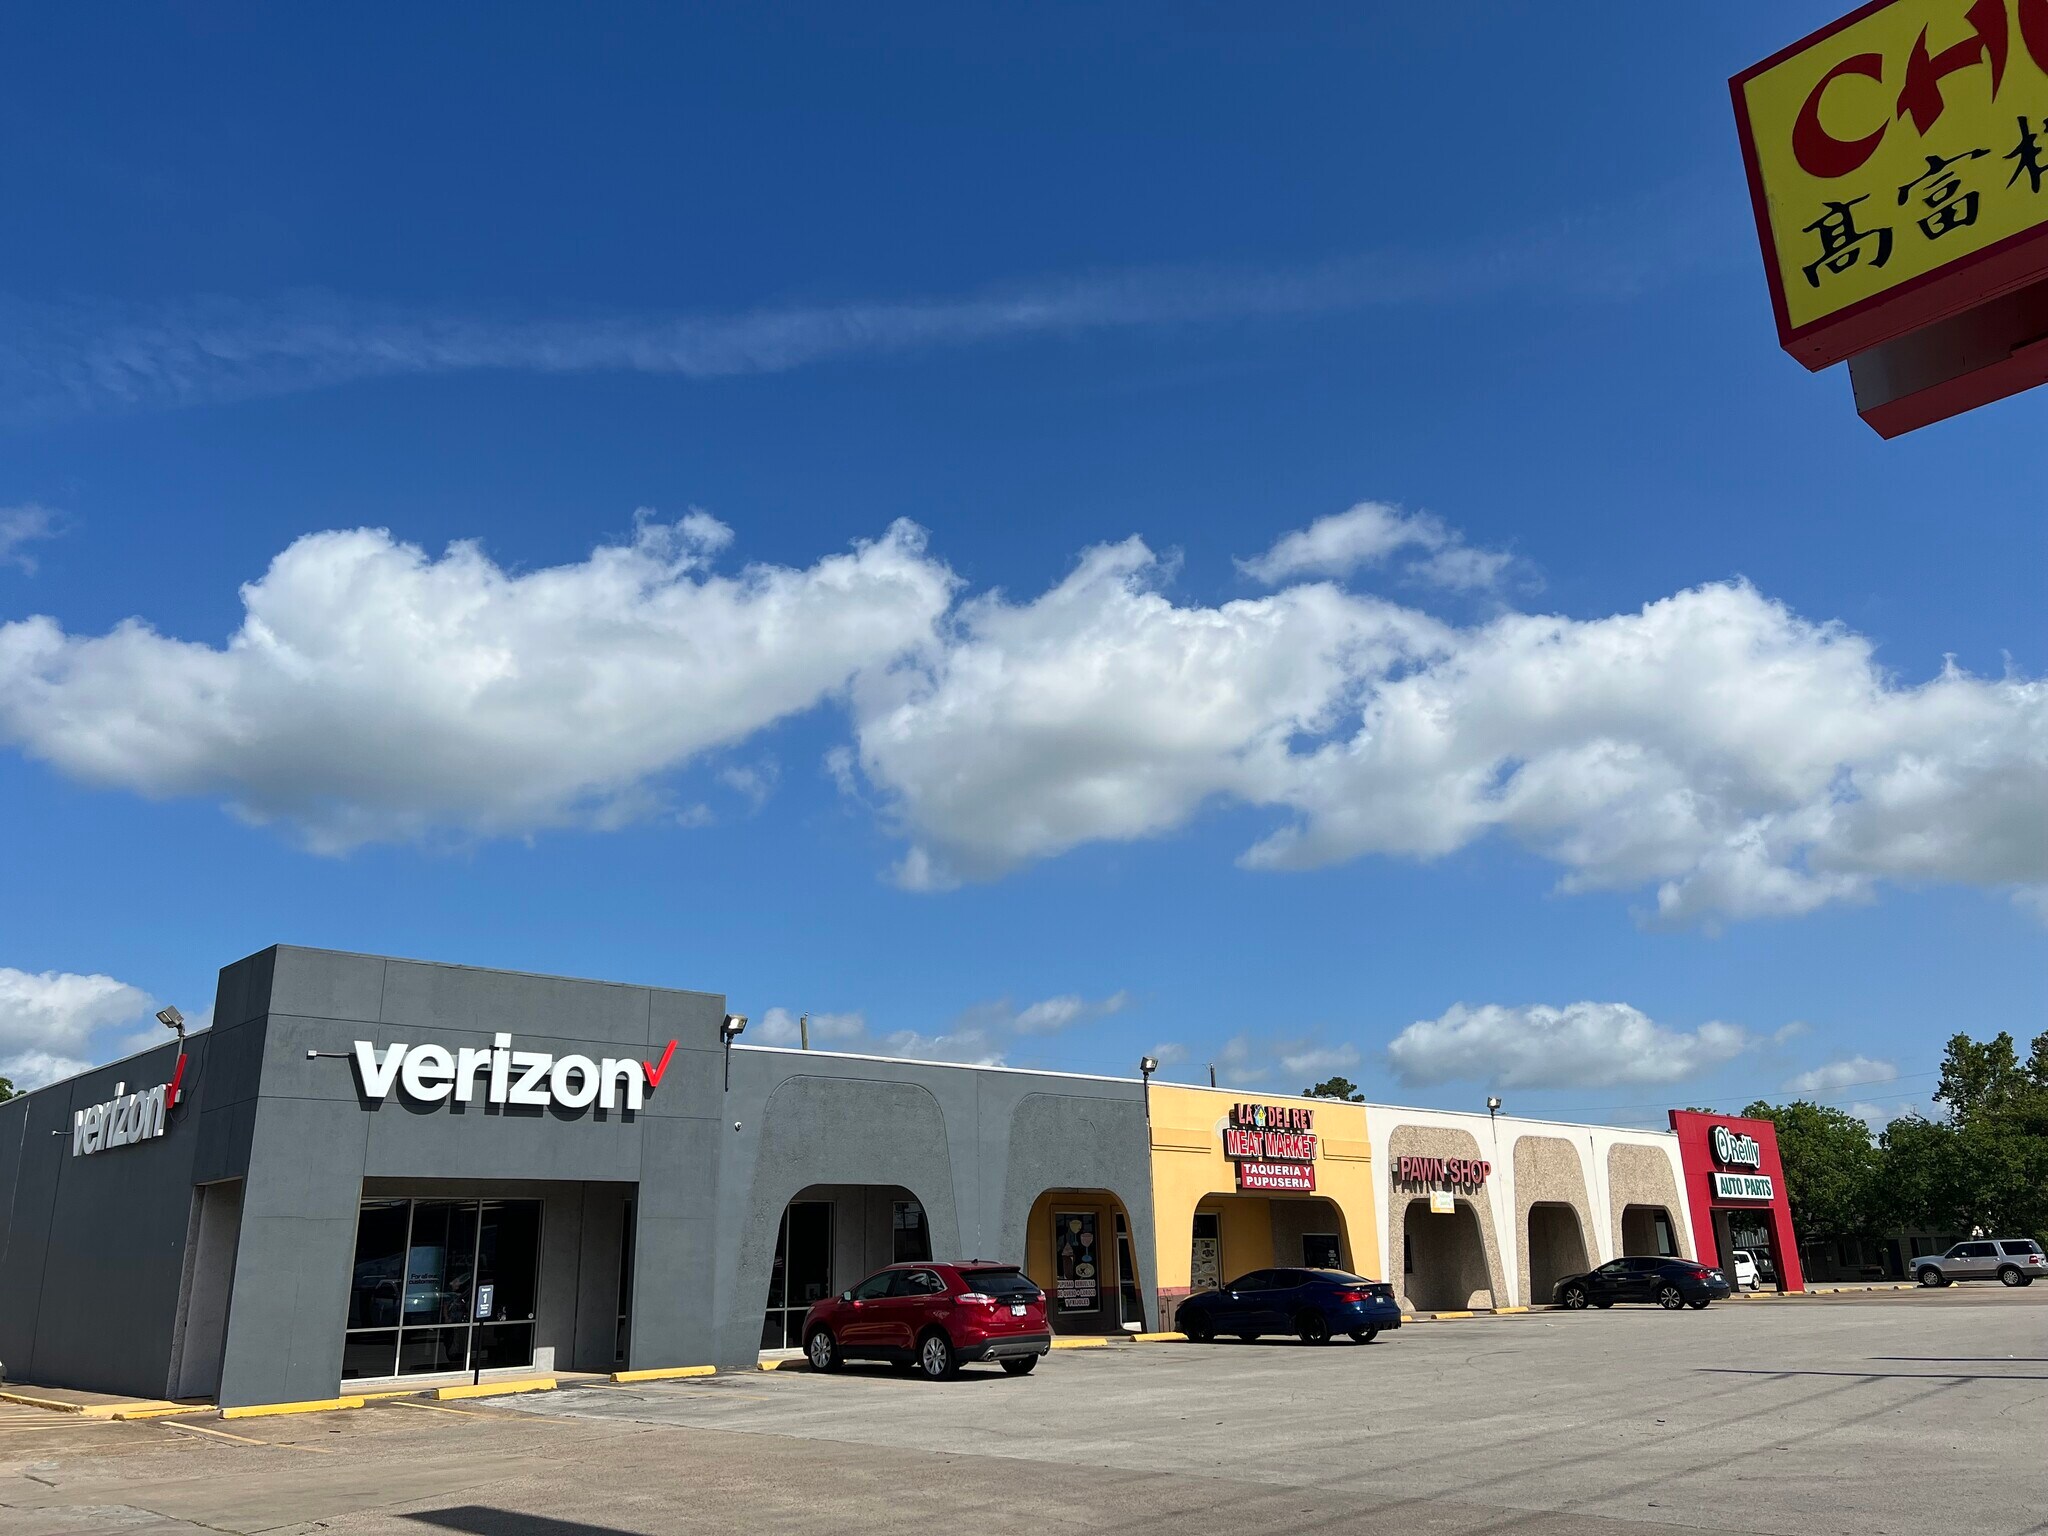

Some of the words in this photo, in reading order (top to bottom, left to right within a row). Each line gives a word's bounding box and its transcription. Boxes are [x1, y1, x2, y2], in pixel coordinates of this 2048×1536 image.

[354, 1033, 644, 1110] verizon
[73, 1081, 167, 1157] verizon
[1236, 1103, 1254, 1125] LA
[1267, 1106, 1290, 1128] DEL
[1292, 1108, 1314, 1129] REY
[1227, 1129, 1263, 1155] MEAT
[1265, 1131, 1317, 1159] MARKET
[1715, 1127, 1760, 1168] O'Reilly
[1243, 1164, 1301, 1176] TAQUERIA
[1303, 1167, 1311, 1176] Y
[1246, 1176, 1311, 1188] PUPUSERIA
[1400, 1156, 1445, 1181] PAWN
[1449, 1157, 1492, 1183] SHOP
[1720, 1177, 1743, 1195] AUTO
[1744, 1178, 1772, 1196] PARTS
[482, 1293, 488, 1303] 1
